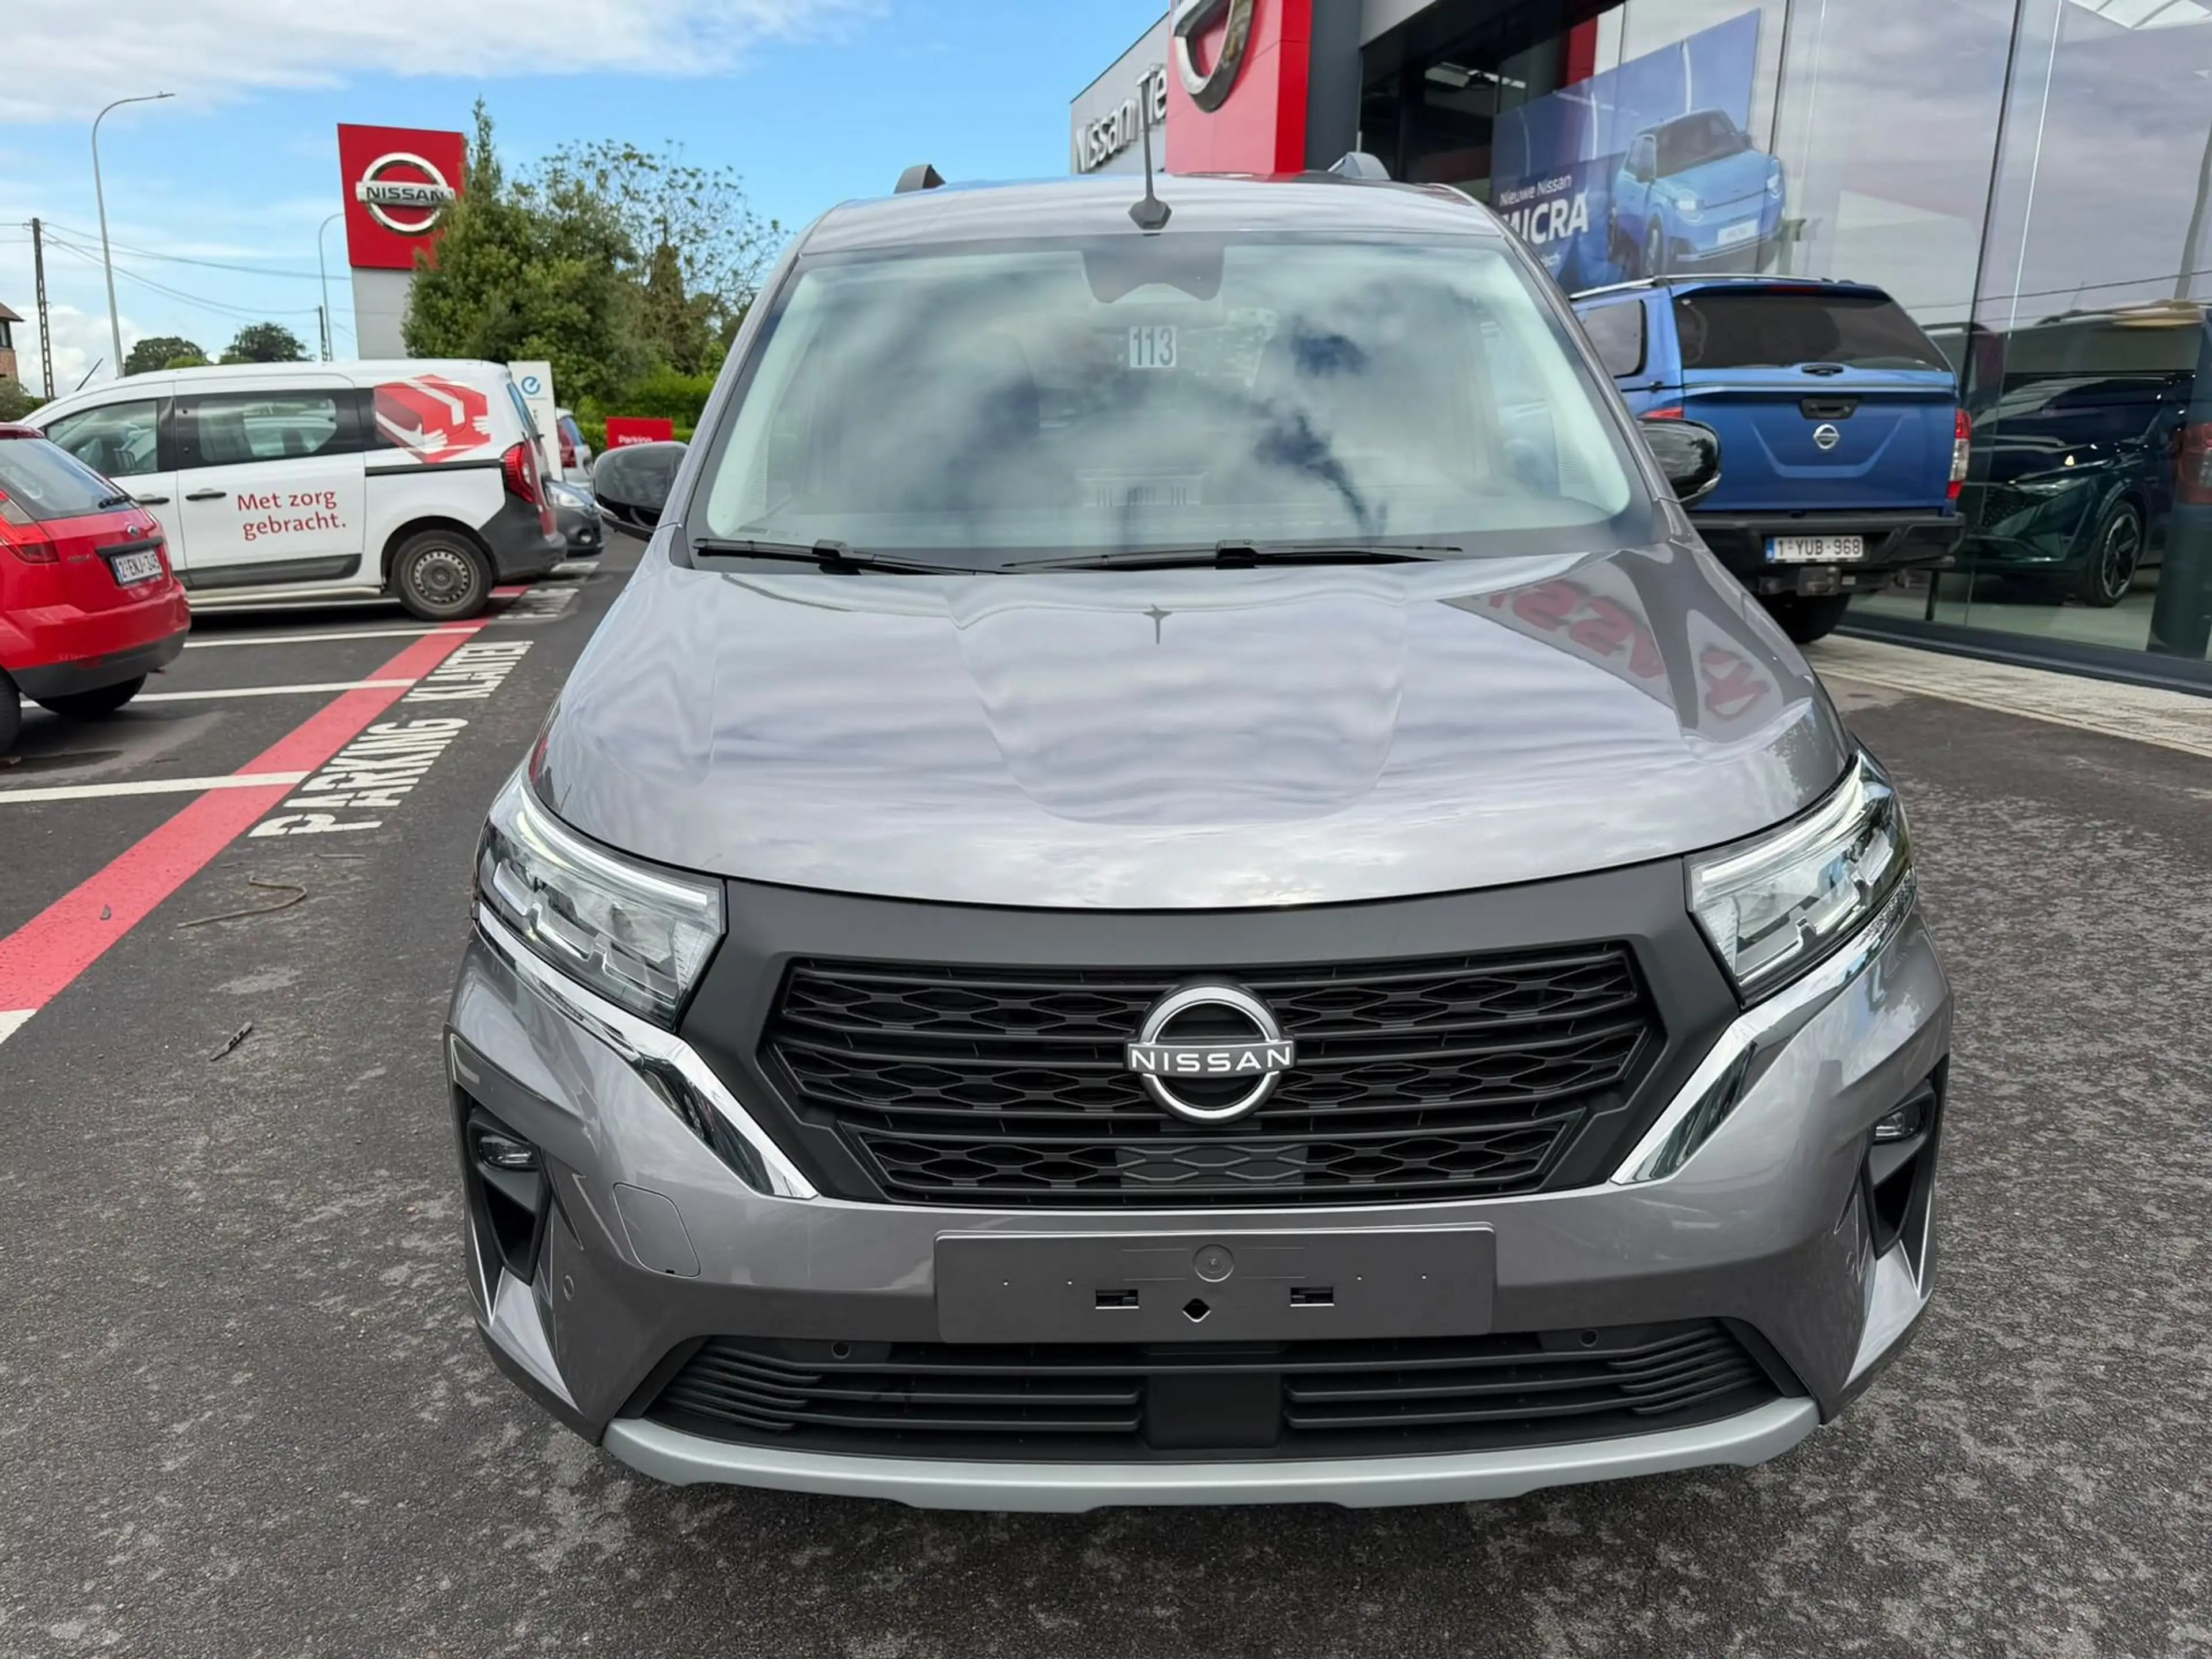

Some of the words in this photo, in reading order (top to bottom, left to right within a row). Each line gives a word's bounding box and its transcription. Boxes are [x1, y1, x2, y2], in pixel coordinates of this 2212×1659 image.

[1075, 98, 1139, 172] Nissan
[366, 186, 444, 202] NISSAN
[1499, 186, 1536, 207] Nieuwe
[1537, 175, 1571, 197] Nissan
[1133, 327, 1174, 366] 113
[237, 493, 282, 511] Met
[288, 491, 337, 510] zorg
[243, 511, 346, 541] gebracht.
[248, 717, 469, 838] PARKING
[1132, 1046, 1290, 1072] NISSAN
